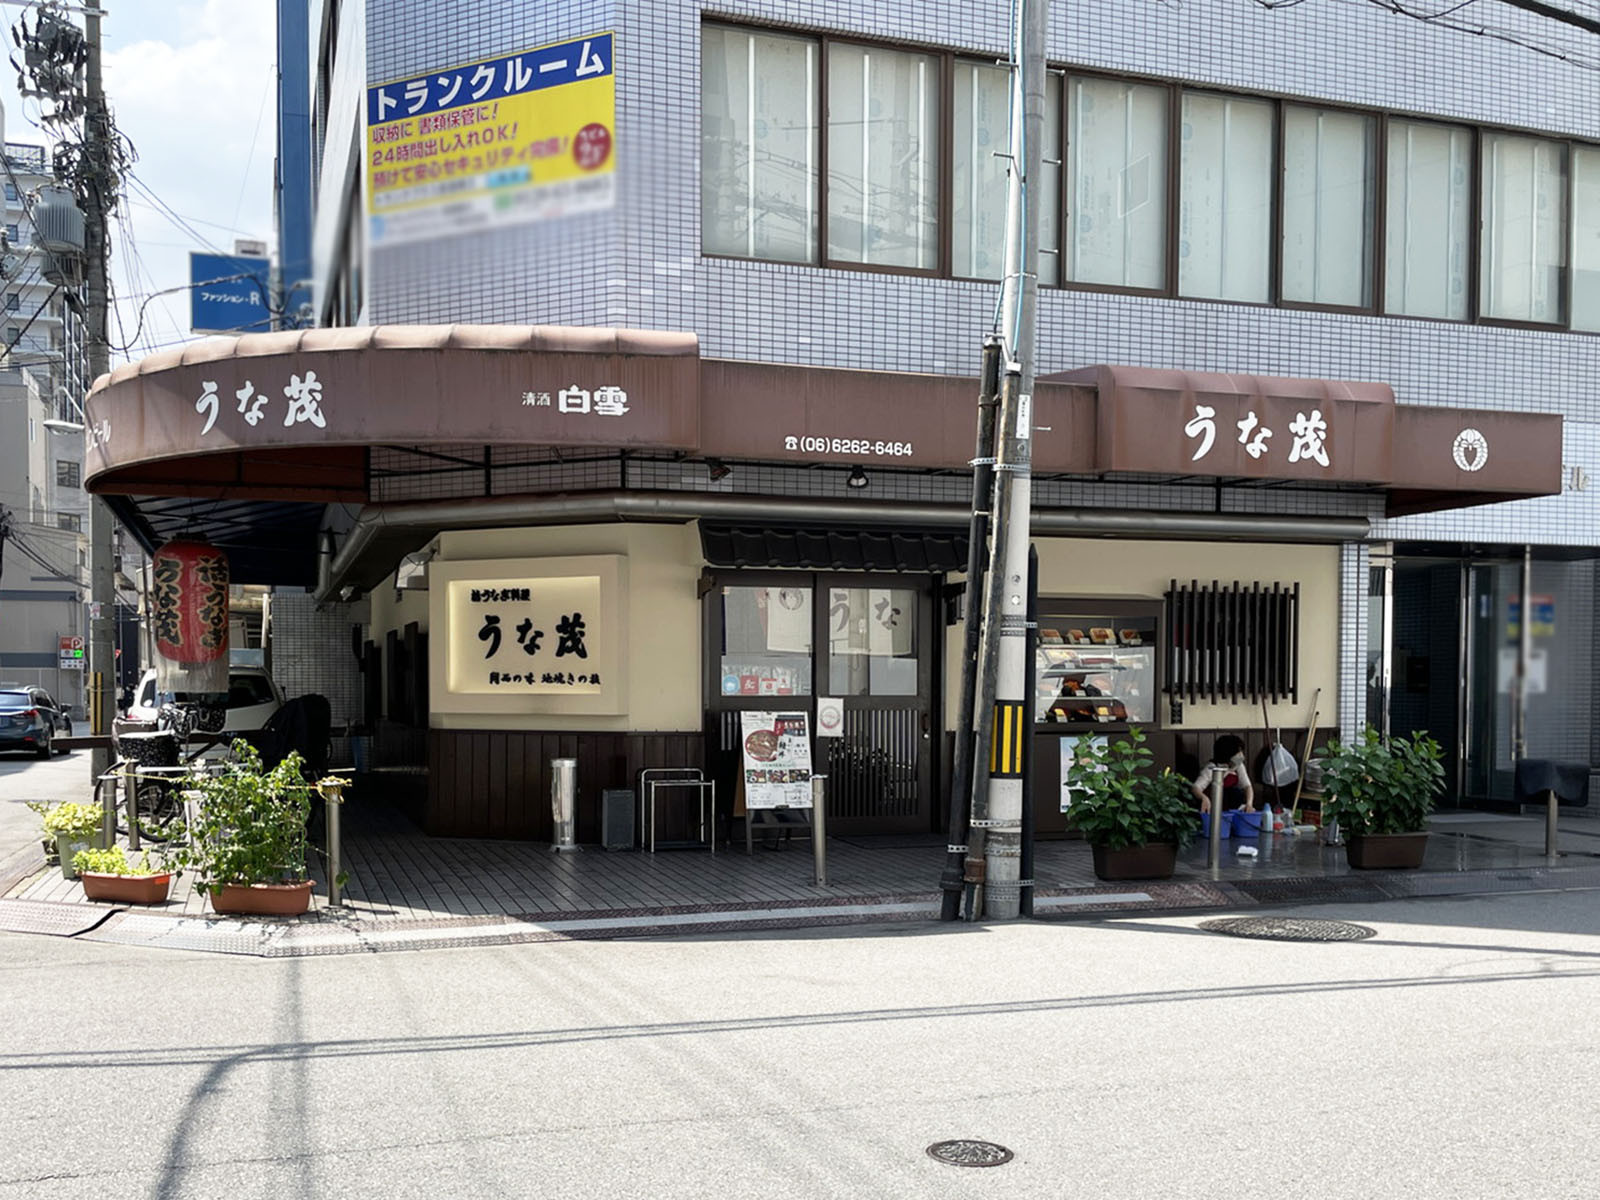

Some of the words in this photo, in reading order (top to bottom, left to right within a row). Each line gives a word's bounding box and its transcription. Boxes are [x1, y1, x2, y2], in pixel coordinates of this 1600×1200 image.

[377, 41, 606, 121] トランクルーム
[195, 370, 327, 436] うな茂
[522, 391, 551, 407] 清酒
[558, 384, 630, 416] 白雪
[800, 436, 913, 456] (06)6262-6464
[1185, 405, 1331, 468] うな茂
[478, 612, 588, 660] うな茂
